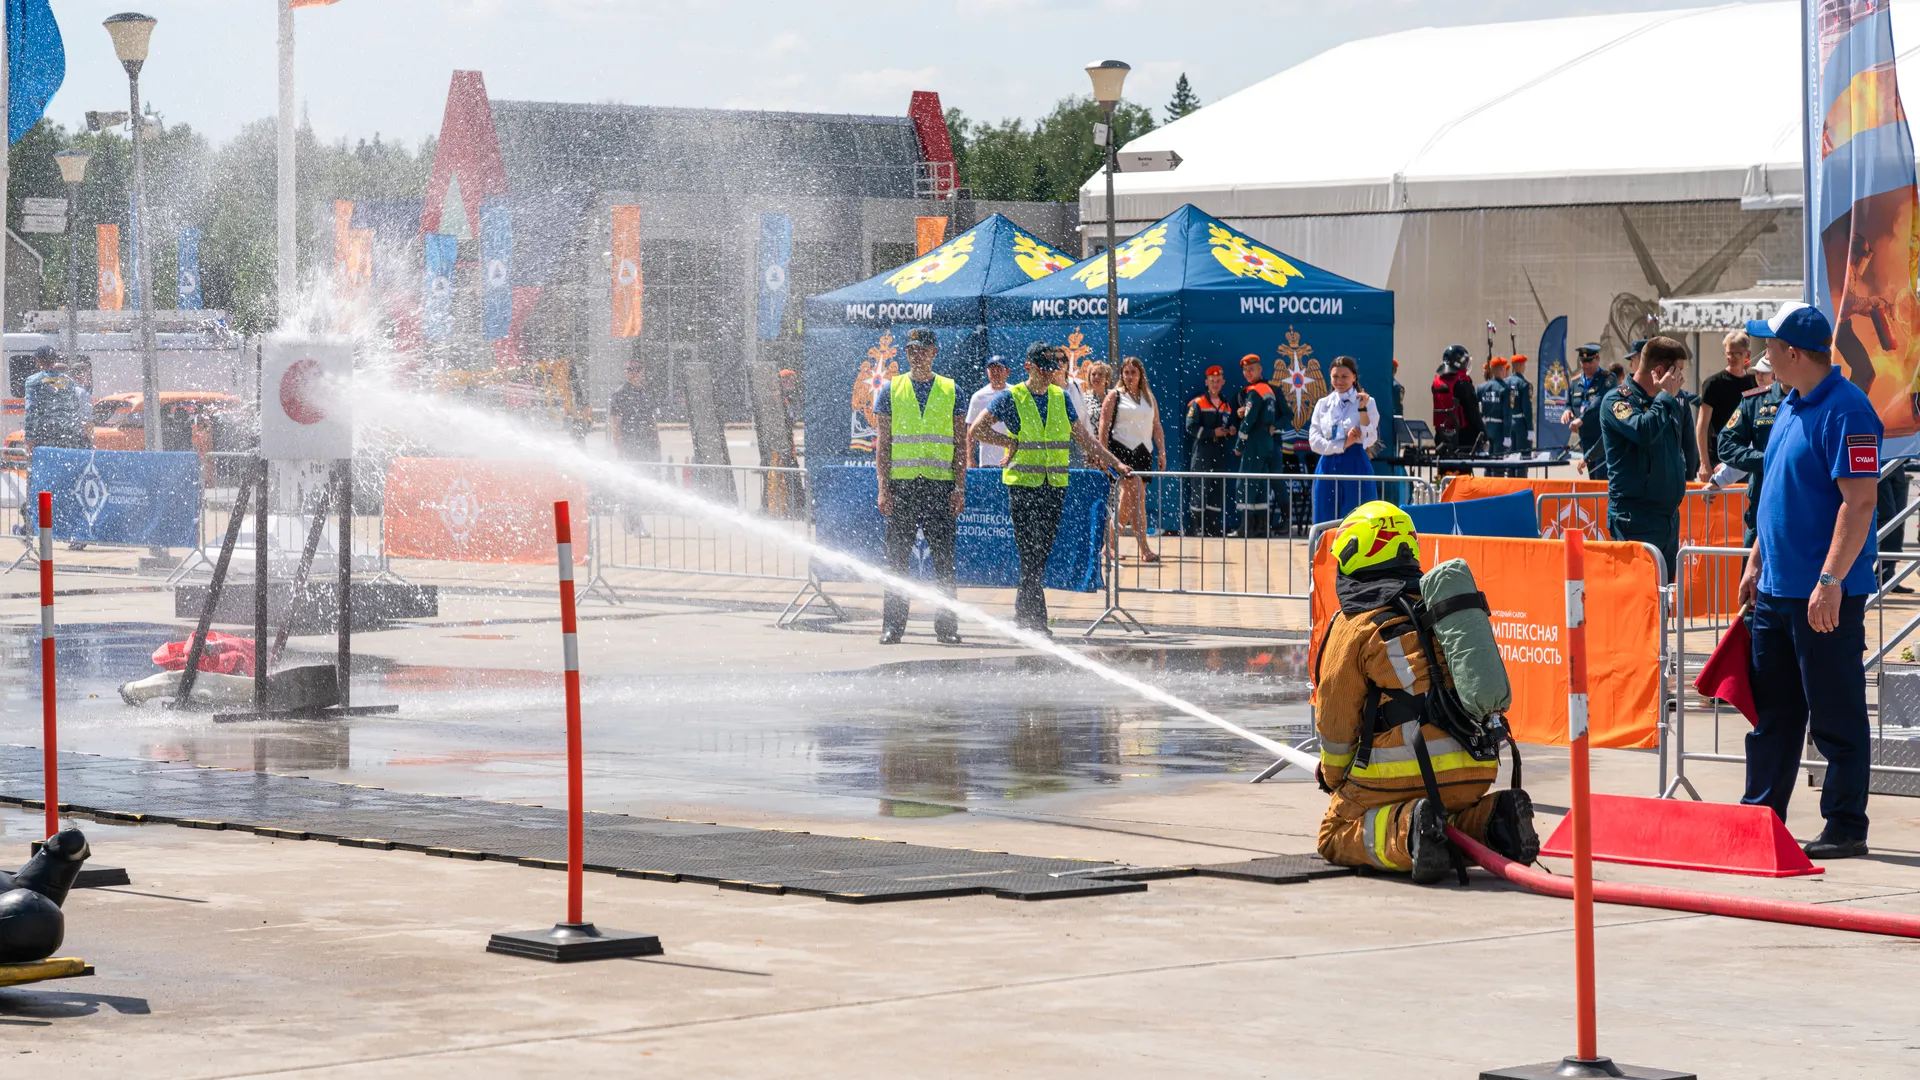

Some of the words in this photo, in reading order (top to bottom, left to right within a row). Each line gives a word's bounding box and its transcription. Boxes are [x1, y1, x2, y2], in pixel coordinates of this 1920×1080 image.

[846, 303, 876, 320] МЧС
[878, 303, 934, 320] РОССИИ
[1031, 299, 1065, 317] МЧС
[1068, 297, 1129, 316] РОССИ
[1240, 296, 1275, 314] МЧС
[1278, 295, 1343, 315] РОССИИ
[956, 513, 1014, 526] ОМПЛЕКСНА
[1491, 621, 1559, 642] МПЛЕКСНАЯ
[1496, 644, 1562, 665] ОПАСНОСТЬ
